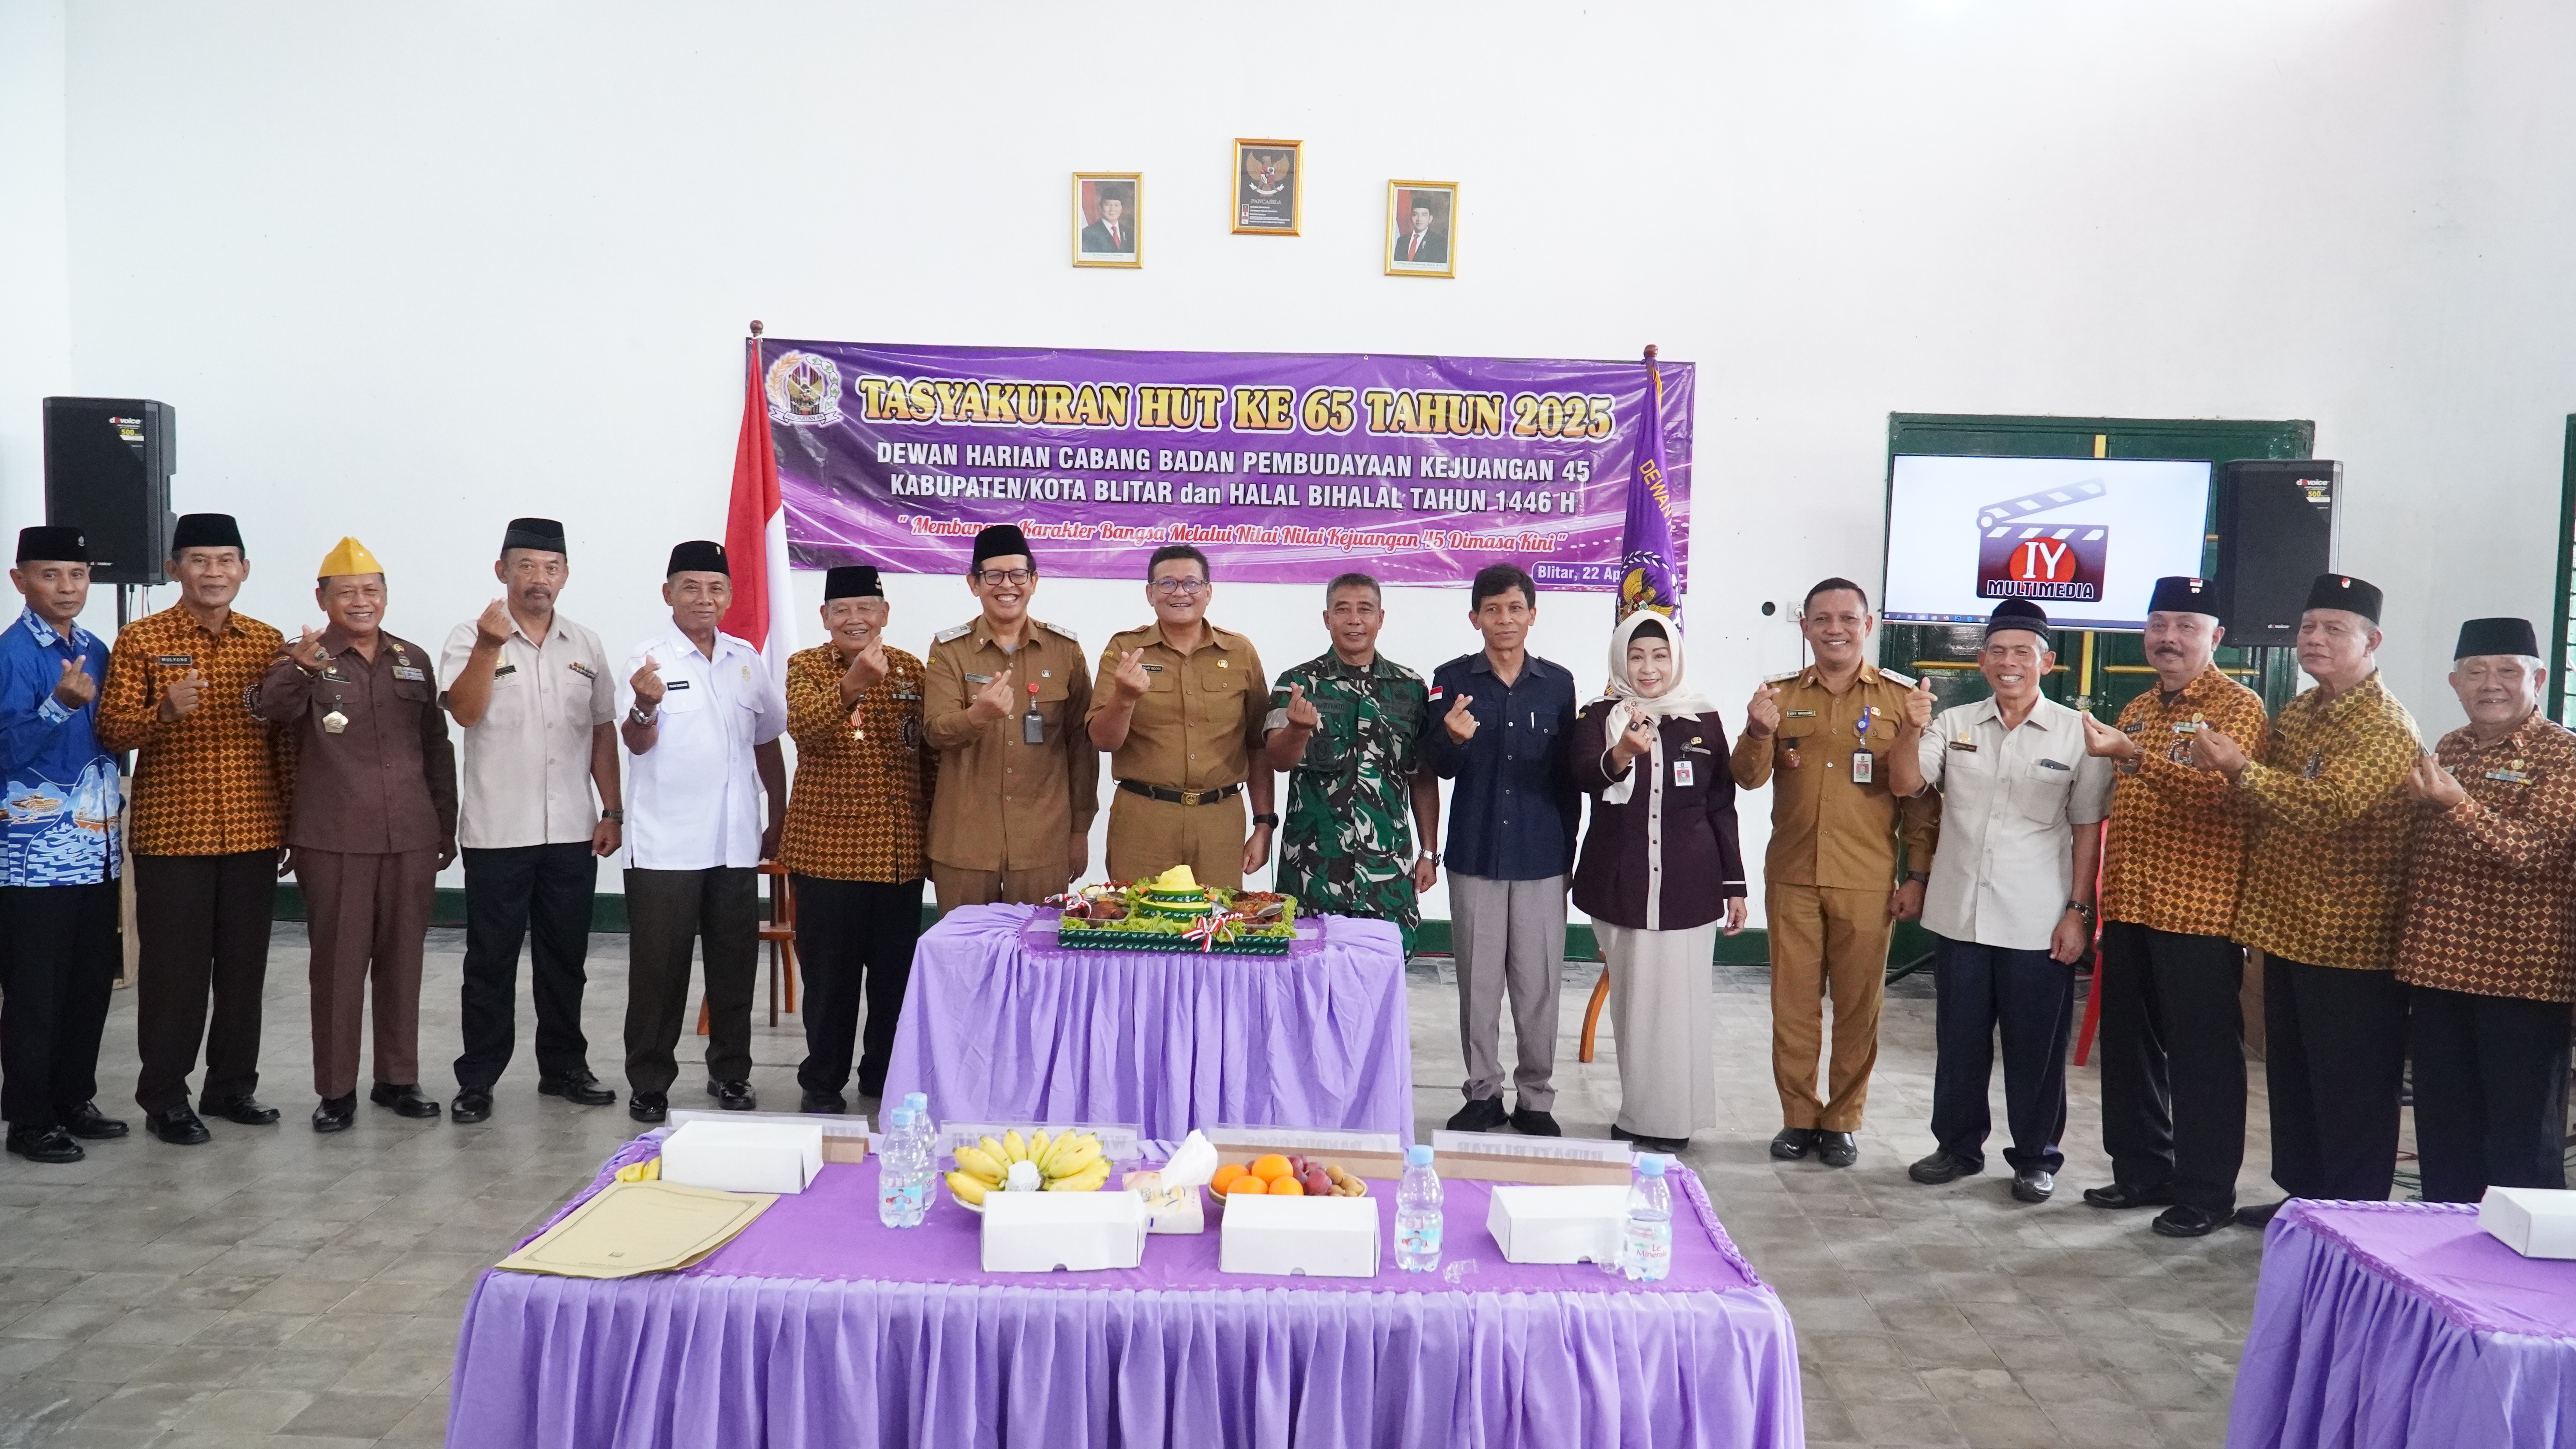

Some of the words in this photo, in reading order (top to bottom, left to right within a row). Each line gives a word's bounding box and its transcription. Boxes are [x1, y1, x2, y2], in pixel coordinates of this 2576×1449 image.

[860, 379, 1129, 426] TASYAKURAN
[1138, 386, 1223, 428] HUT
[1234, 389, 1292, 430] KE
[1303, 389, 1353, 431] 65
[1366, 392, 1503, 436] TAHUN
[1514, 396, 1612, 437] 2025
[878, 442, 957, 465] DEWAN
[966, 445, 1050, 468] HARIAN
[1059, 447, 1150, 471] CABANG
[1160, 450, 1234, 473] BADAN
[1243, 452, 1411, 477] PEMBUDAYAAN
[1421, 456, 1553, 481] KEJUANGAN
[1562, 460, 1589, 481] 45
[891, 475, 1085, 501] KABUPATEN/KOTA
[1095, 480, 1172, 503] BLITAR
[1181, 483, 1220, 503] dan
[1230, 484, 1300, 506] HALAL
[1308, 485, 1403, 509] BIHALAL
[1411, 488, 1485, 512] TAHUN
[1495, 490, 1551, 512] 1446
[1560, 492, 1575, 512] H
[1639, 459, 1672, 518] DEWAN
[1020, 520, 1096, 537] Karakter
[1101, 523, 1164, 543] Bangsa
[1172, 524, 1232, 542] Melalui
[1237, 526, 1278, 543] Nilai
[1285, 527, 1324, 544] Nilai
[1330, 530, 1418, 552] Kejuangan
[1422, 531, 1445, 548] 45
[1450, 532, 1515, 549] Dimasa
[1538, 565, 1578, 581] Blitar,
[1583, 567, 1599, 579] 22
[2023, 542, 2066, 579] IY
[1987, 579, 2094, 599] MULTIMEDIA
[1637, 1249, 1667, 1258] Minerale
